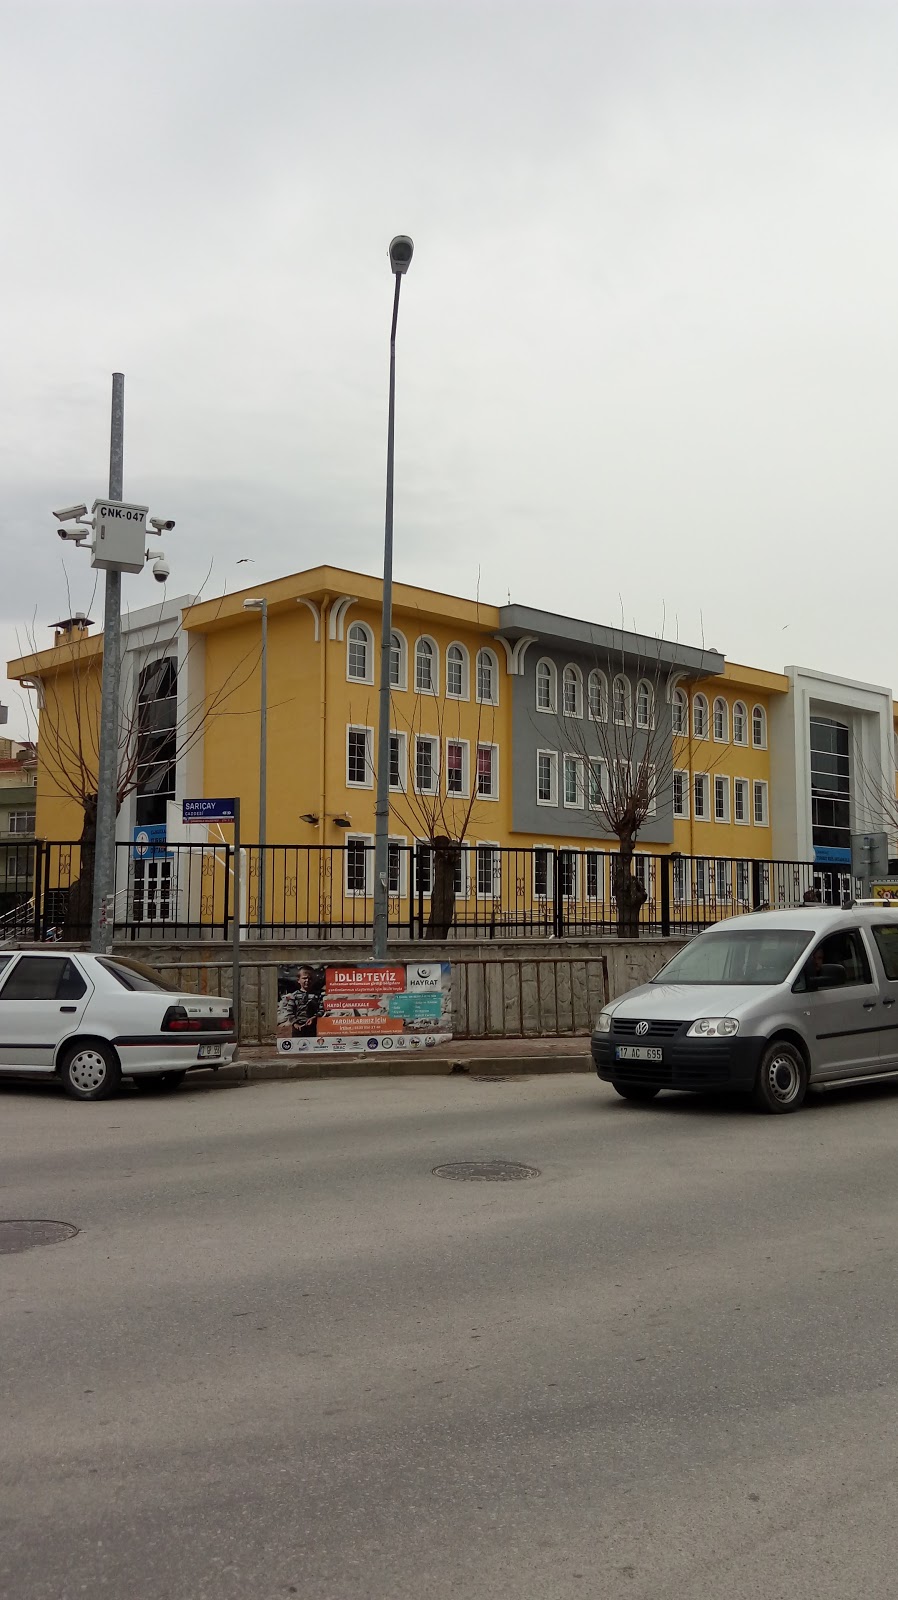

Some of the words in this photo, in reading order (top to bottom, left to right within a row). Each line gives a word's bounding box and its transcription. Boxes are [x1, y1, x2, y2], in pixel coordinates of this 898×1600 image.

[100, 507, 145, 522] ÇNK-047
[185, 802, 216, 811] SARIÇAY
[334, 970, 396, 982] İDLİB'TEYİZ
[620, 1047, 627, 1057] 17
[631, 1048, 640, 1058] AC
[647, 1049, 660, 1059] 695
